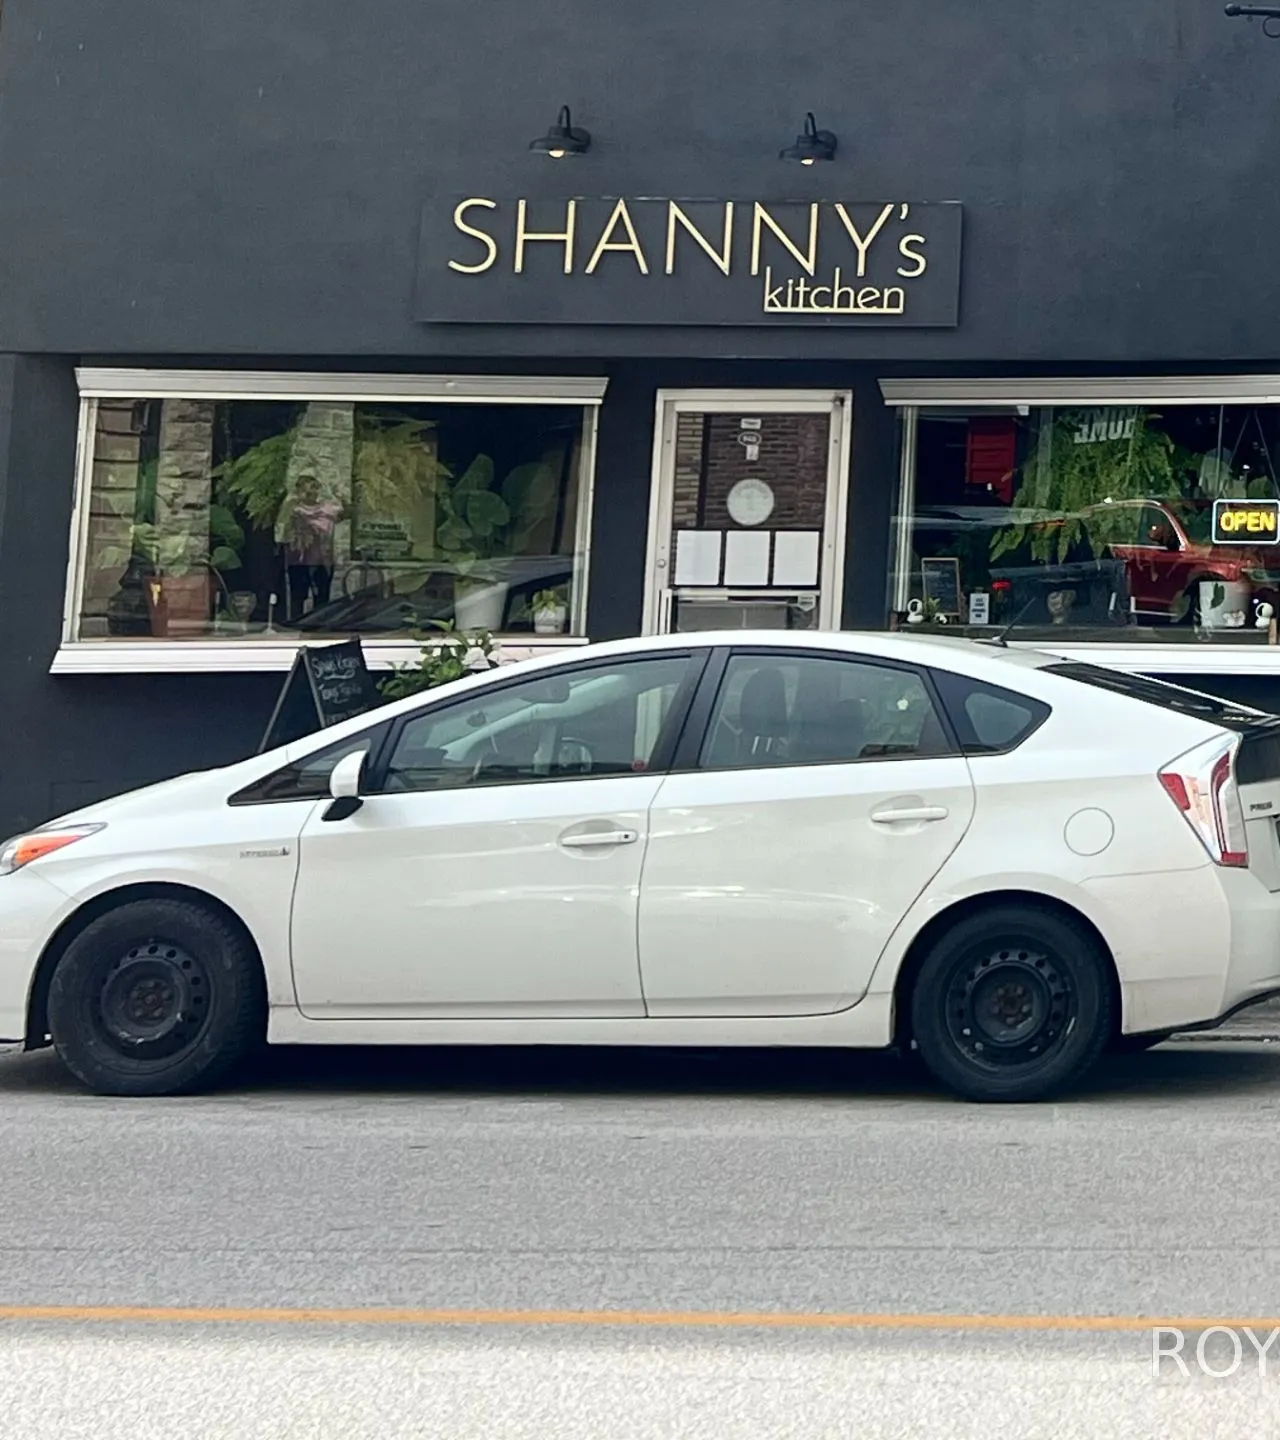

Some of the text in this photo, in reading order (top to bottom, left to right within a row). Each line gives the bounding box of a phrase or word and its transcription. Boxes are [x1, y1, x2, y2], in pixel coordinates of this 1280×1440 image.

[447, 197, 927, 278] SHANNY's
[764, 265, 904, 313] kitchen
[1220, 511, 1276, 532] OPEN
